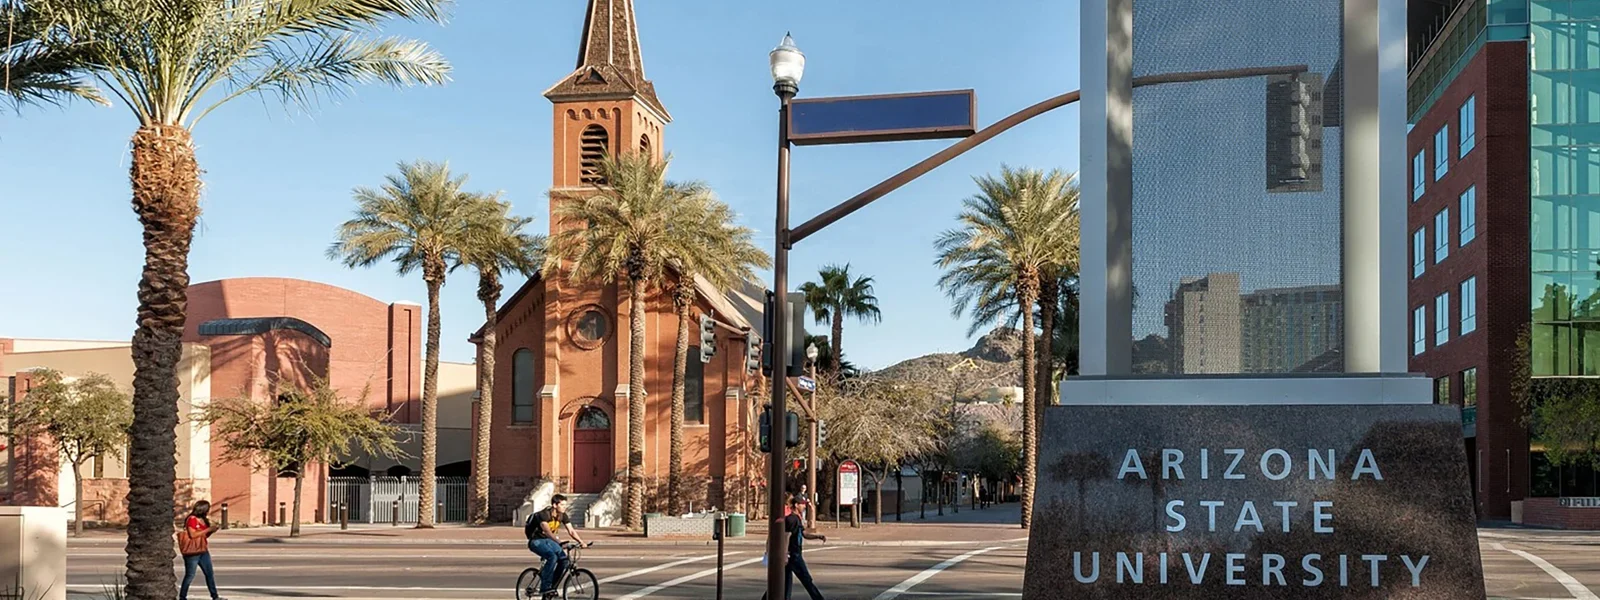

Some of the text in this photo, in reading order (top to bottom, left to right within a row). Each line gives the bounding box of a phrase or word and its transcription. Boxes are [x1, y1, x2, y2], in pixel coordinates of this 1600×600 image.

[1117, 448, 1384, 480] ARIZONA
[1165, 500, 1334, 533] STATE
[1073, 551, 1430, 587] UNIVERSITY
